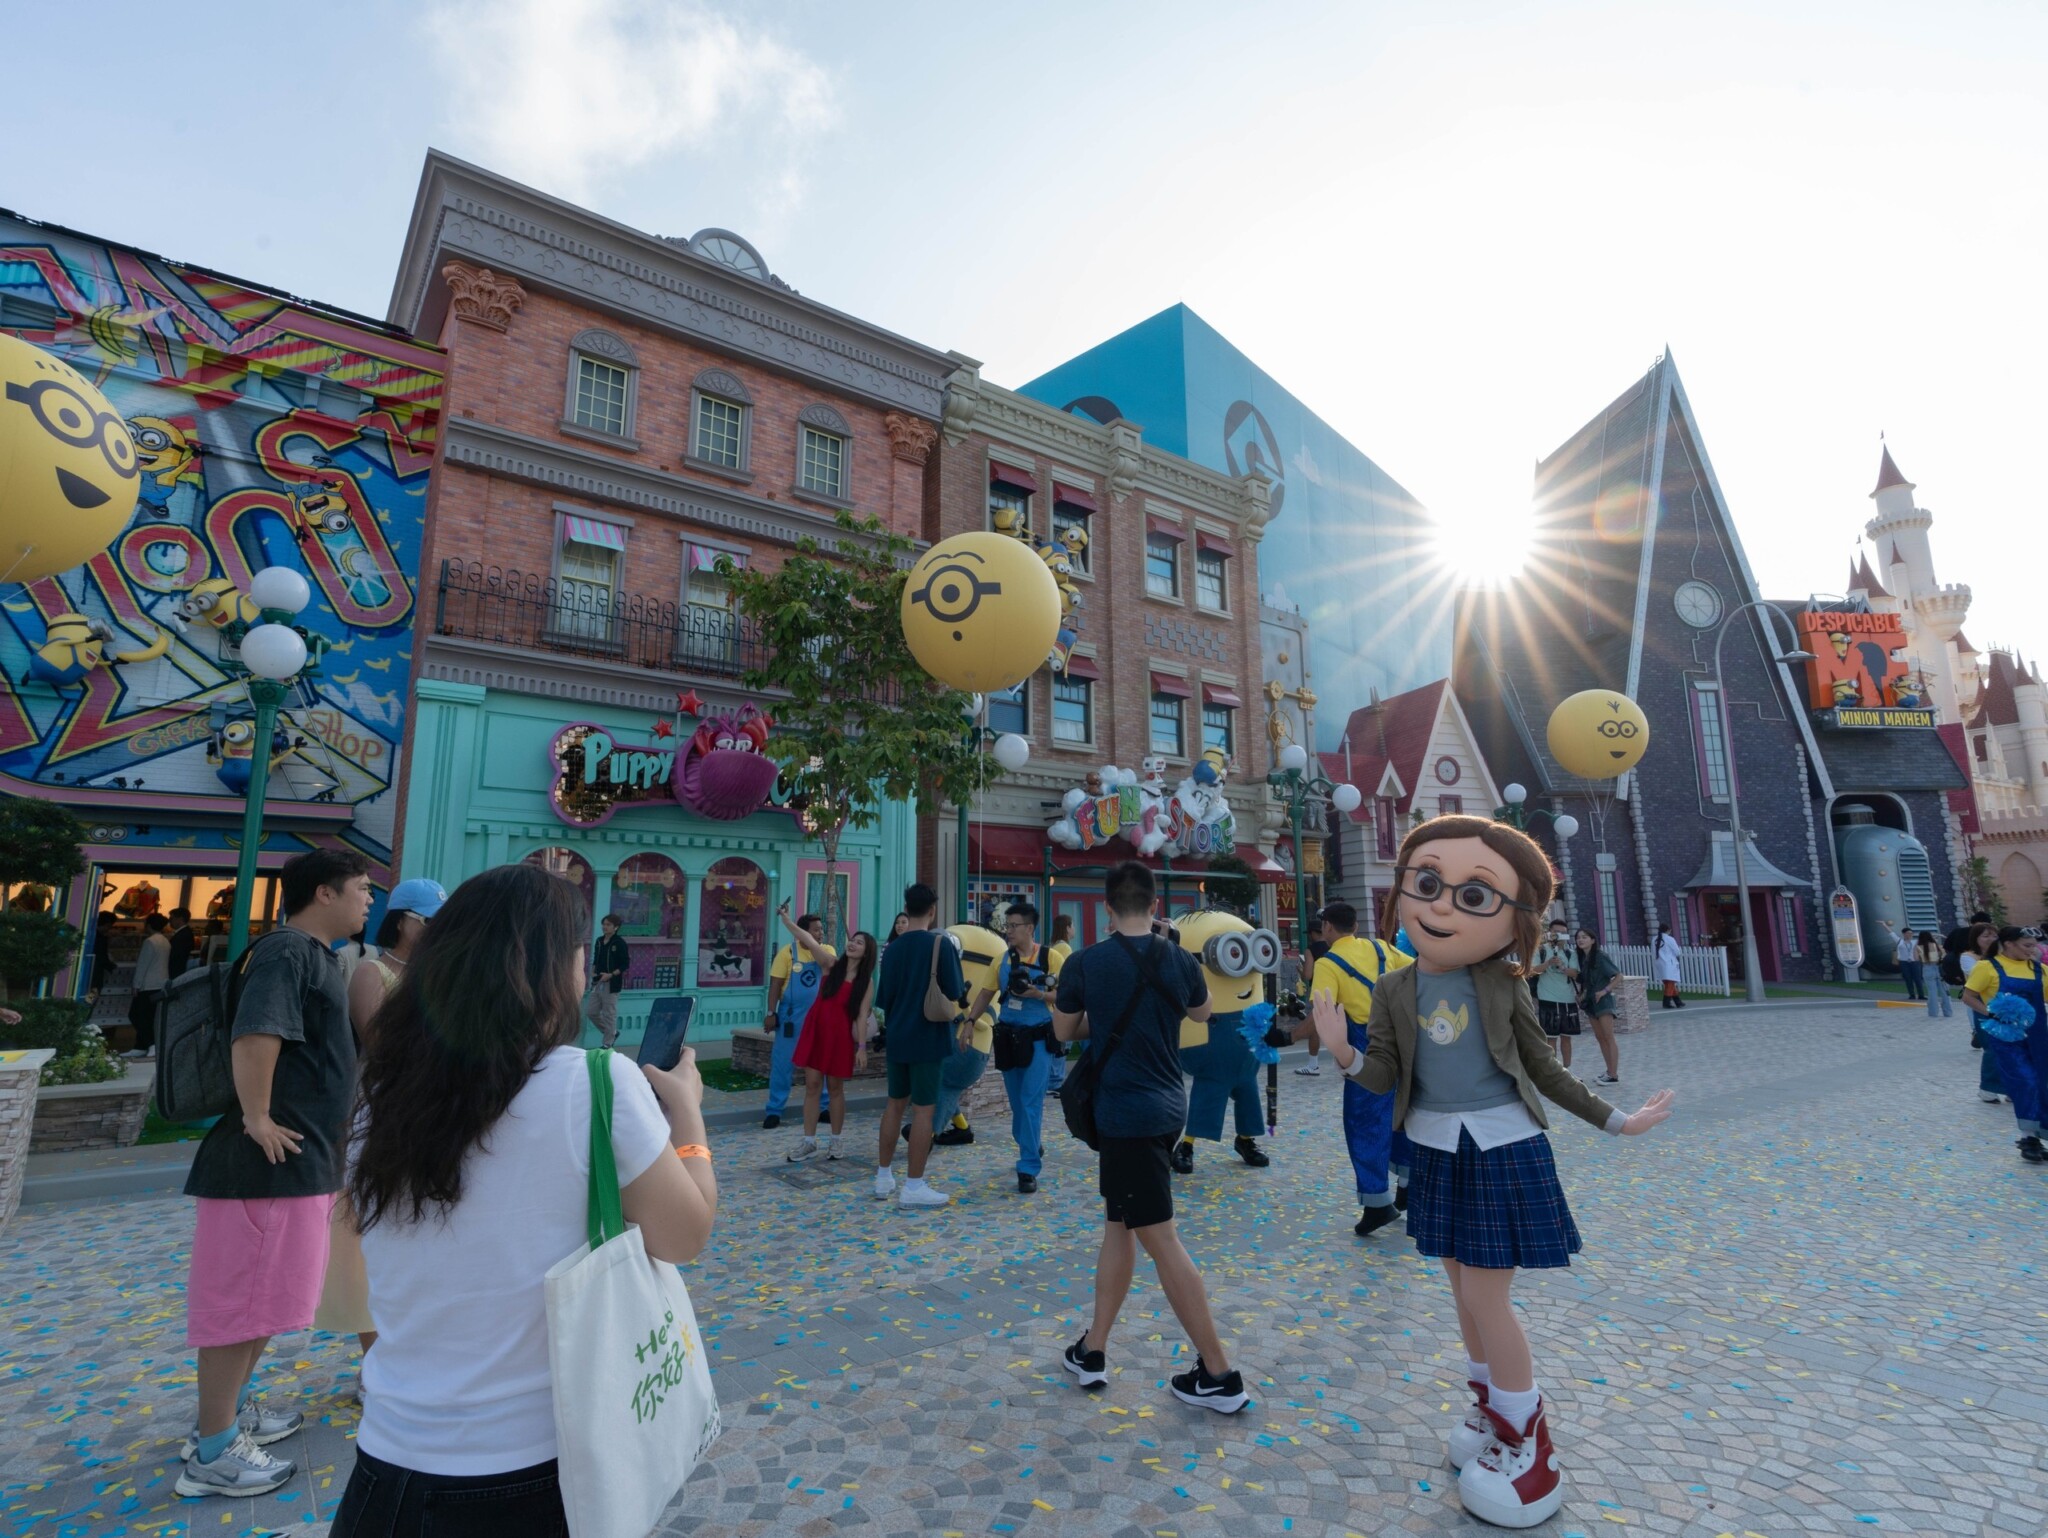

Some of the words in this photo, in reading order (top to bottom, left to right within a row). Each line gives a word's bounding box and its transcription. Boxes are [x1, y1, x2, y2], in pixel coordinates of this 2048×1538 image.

[1804, 612, 1903, 633] DESPICABLE
[1803, 631, 1909, 709] ME
[1839, 710, 1881, 726] MINION
[1883, 711, 1932, 727] MAYHEM
[1074, 784, 1143, 851] FUN
[1166, 796, 1237, 855] STORE
[631, 1340, 686, 1424] 你好
